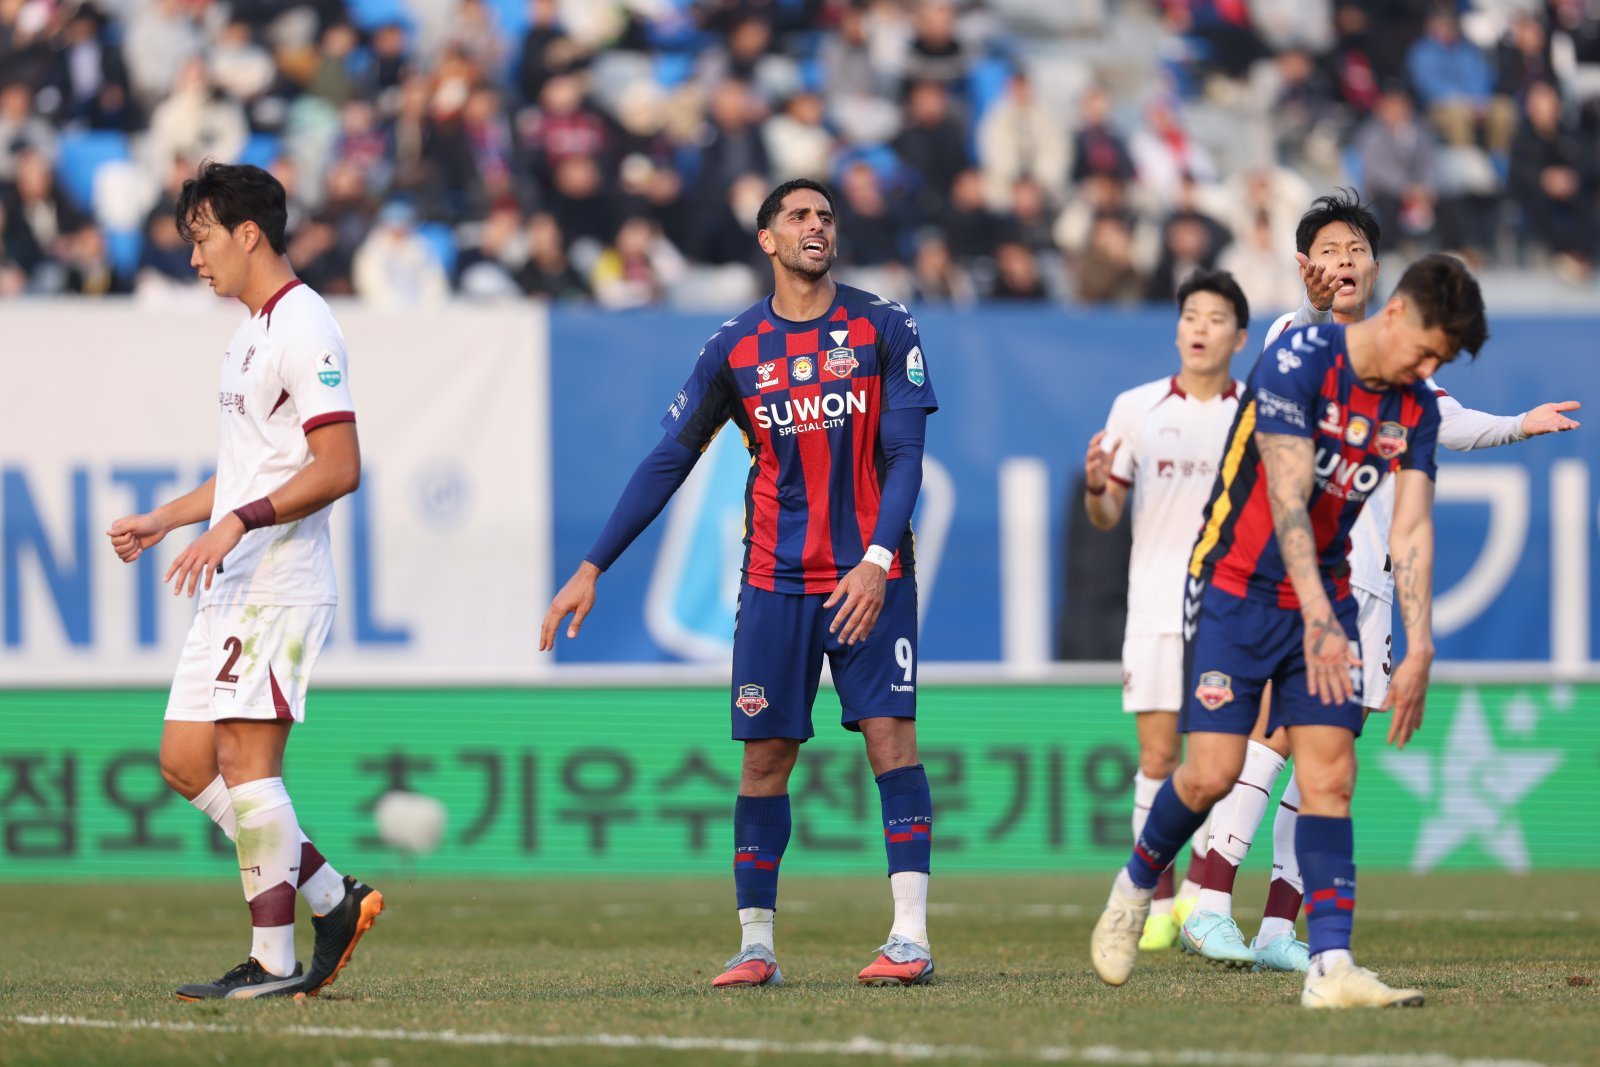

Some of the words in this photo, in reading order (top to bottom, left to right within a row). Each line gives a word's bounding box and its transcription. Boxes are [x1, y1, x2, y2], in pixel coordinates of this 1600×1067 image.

[755, 377, 779, 389] hummel
[754, 390, 866, 429] SUWON
[779, 422, 821, 437] SPECIAL
[822, 418, 845, 429] CITY
[215, 636, 242, 683] 2
[894, 637, 912, 682] 9
[0, 748, 312, 857] 점오
